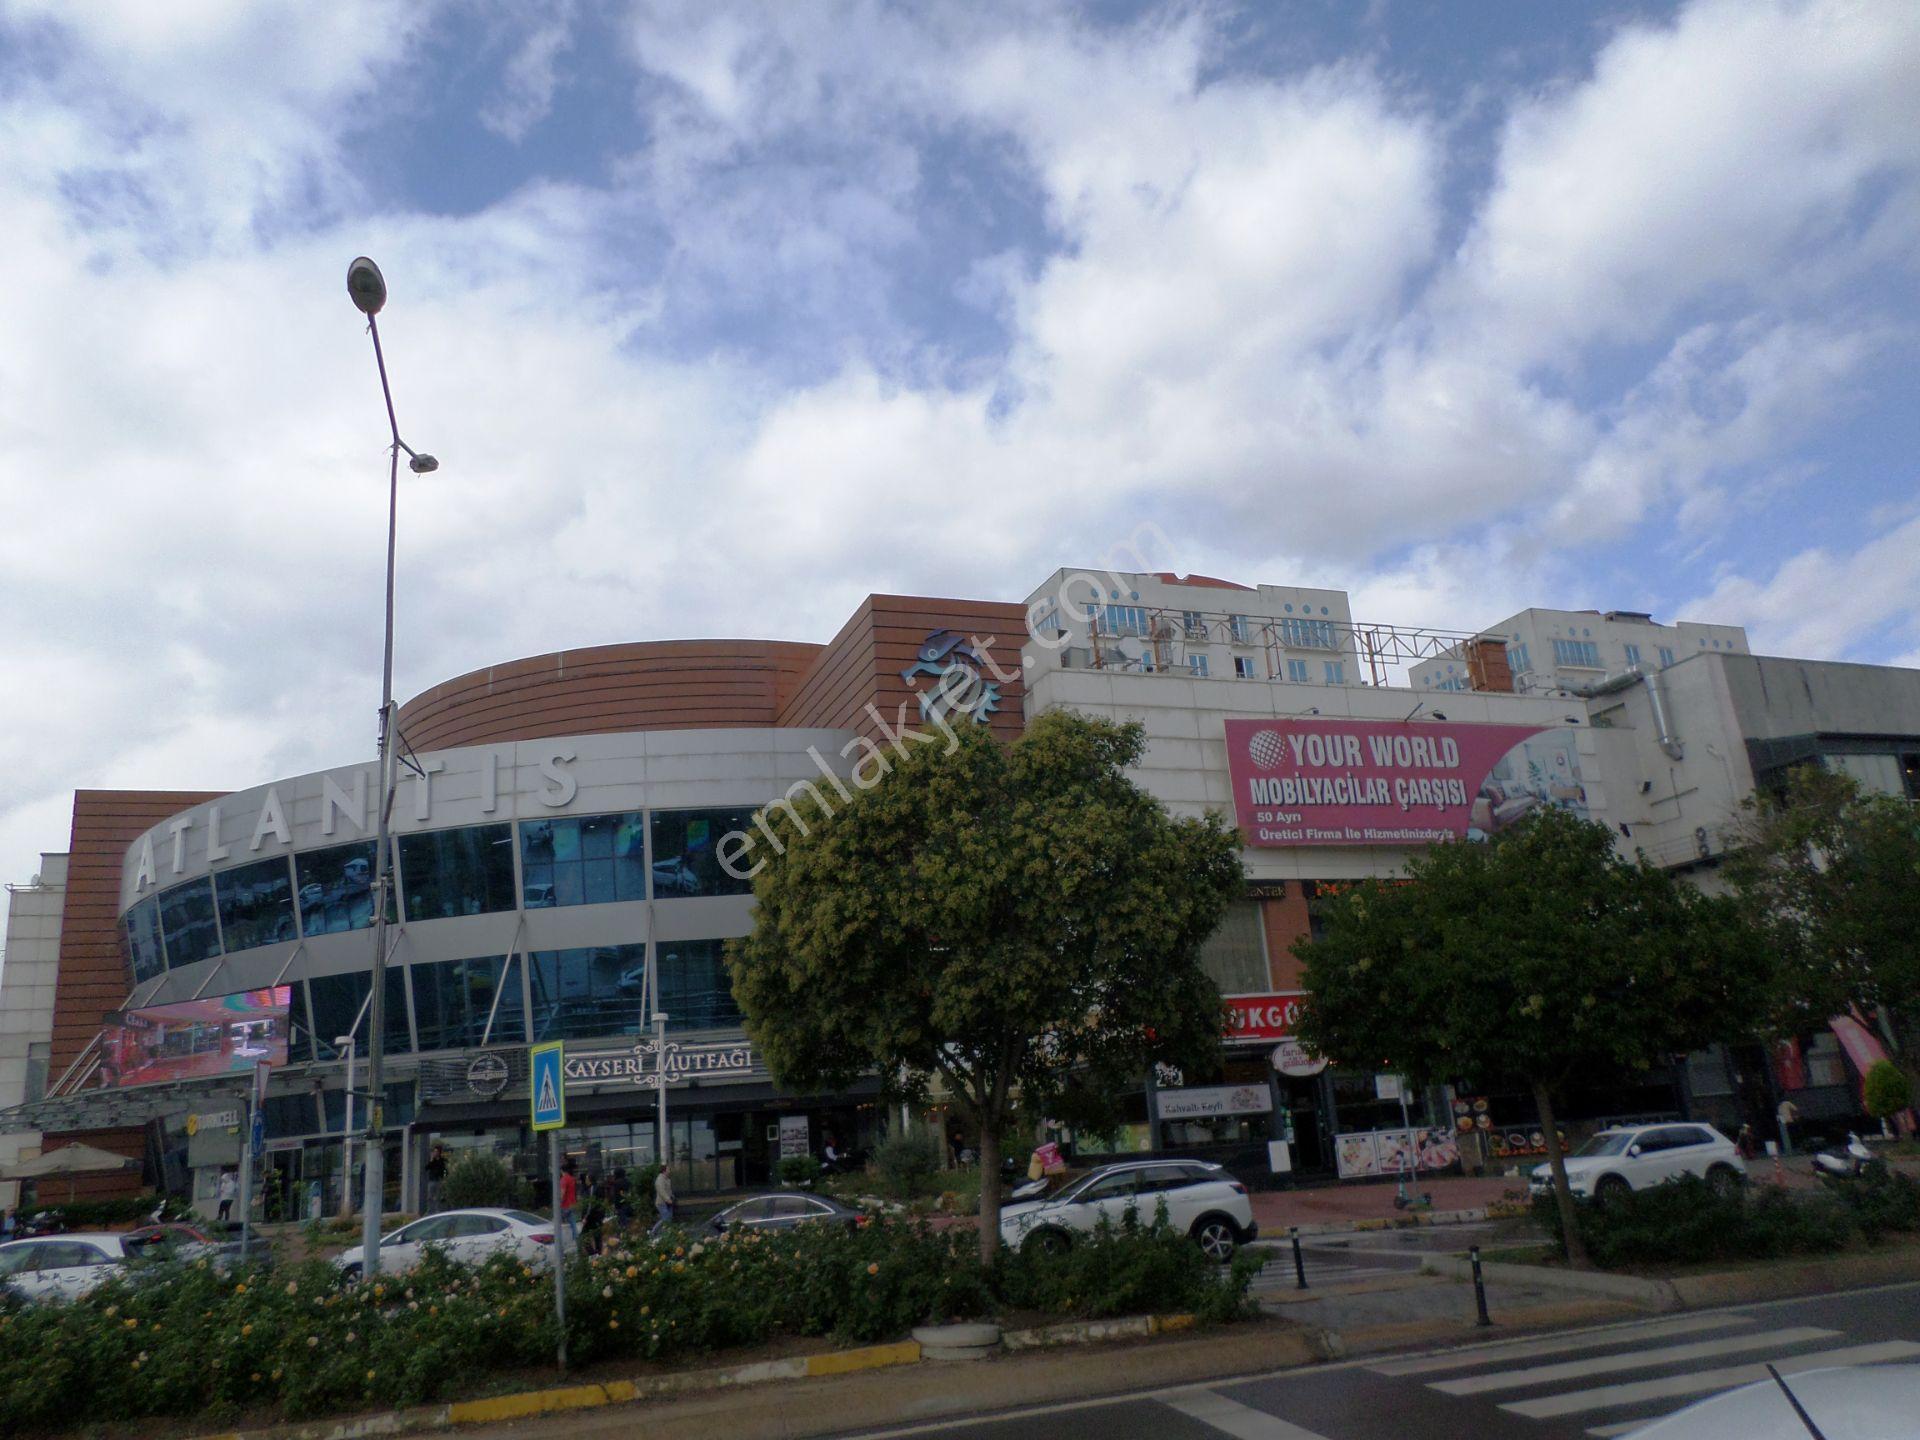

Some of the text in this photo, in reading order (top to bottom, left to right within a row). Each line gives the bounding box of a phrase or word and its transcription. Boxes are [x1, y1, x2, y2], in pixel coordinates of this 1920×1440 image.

[1288, 734, 1461, 768] YOUR WORLD
[1249, 771, 1468, 811] MOBİLYACİLAR ÇARŞISI
[135, 752, 577, 892] ATLANTIS
[1257, 811, 1302, 825] 50 Ayrı
[1260, 826, 1303, 840] Üretici
[1306, 828, 1342, 840] Firma
[656, 1047, 752, 1072] MUTFAĞI
